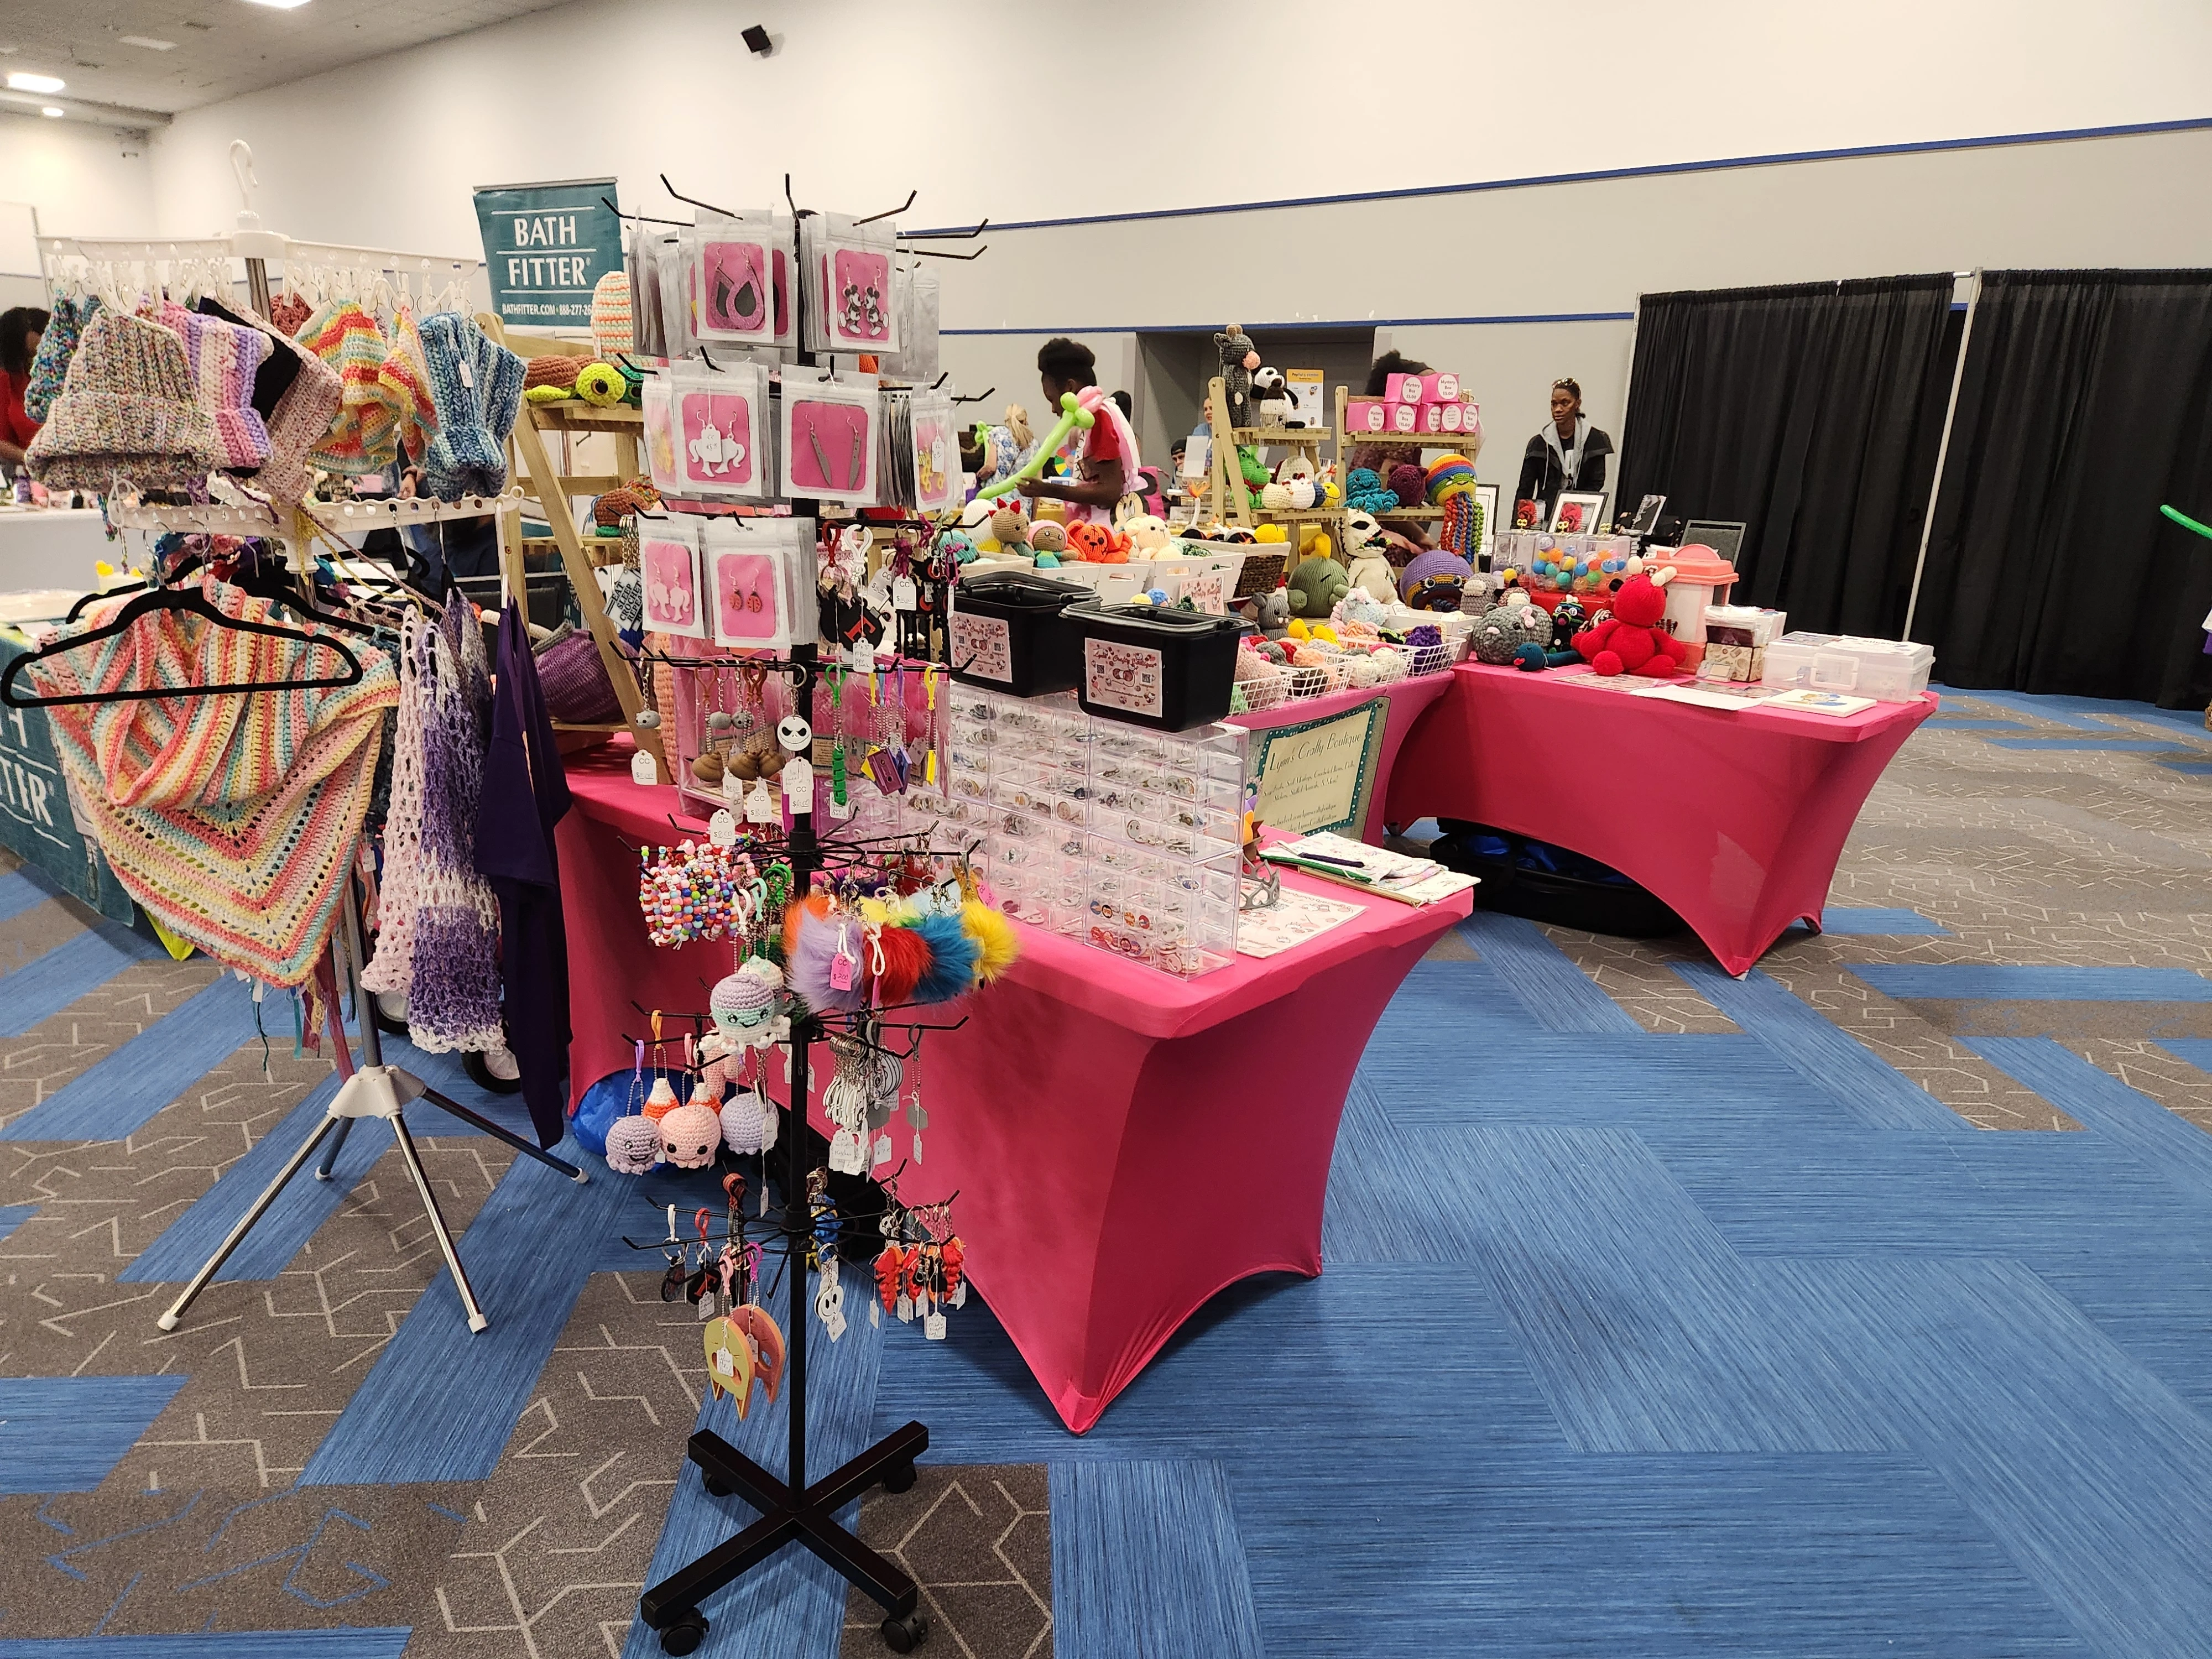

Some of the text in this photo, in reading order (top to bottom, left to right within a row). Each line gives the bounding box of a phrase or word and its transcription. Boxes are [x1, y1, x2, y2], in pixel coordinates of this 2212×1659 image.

[514, 215, 576, 247] BATH
[502, 303, 592, 316] BATHFITTER.COM 888-277-26
[882, 571, 891, 580] CC
[617, 583, 632, 609] SLEEP
[619, 581, 642, 621] CROCHET
[627, 592, 642, 622] REPEA
[1270, 732, 1361, 773] Lynn's Crafty Boutique
